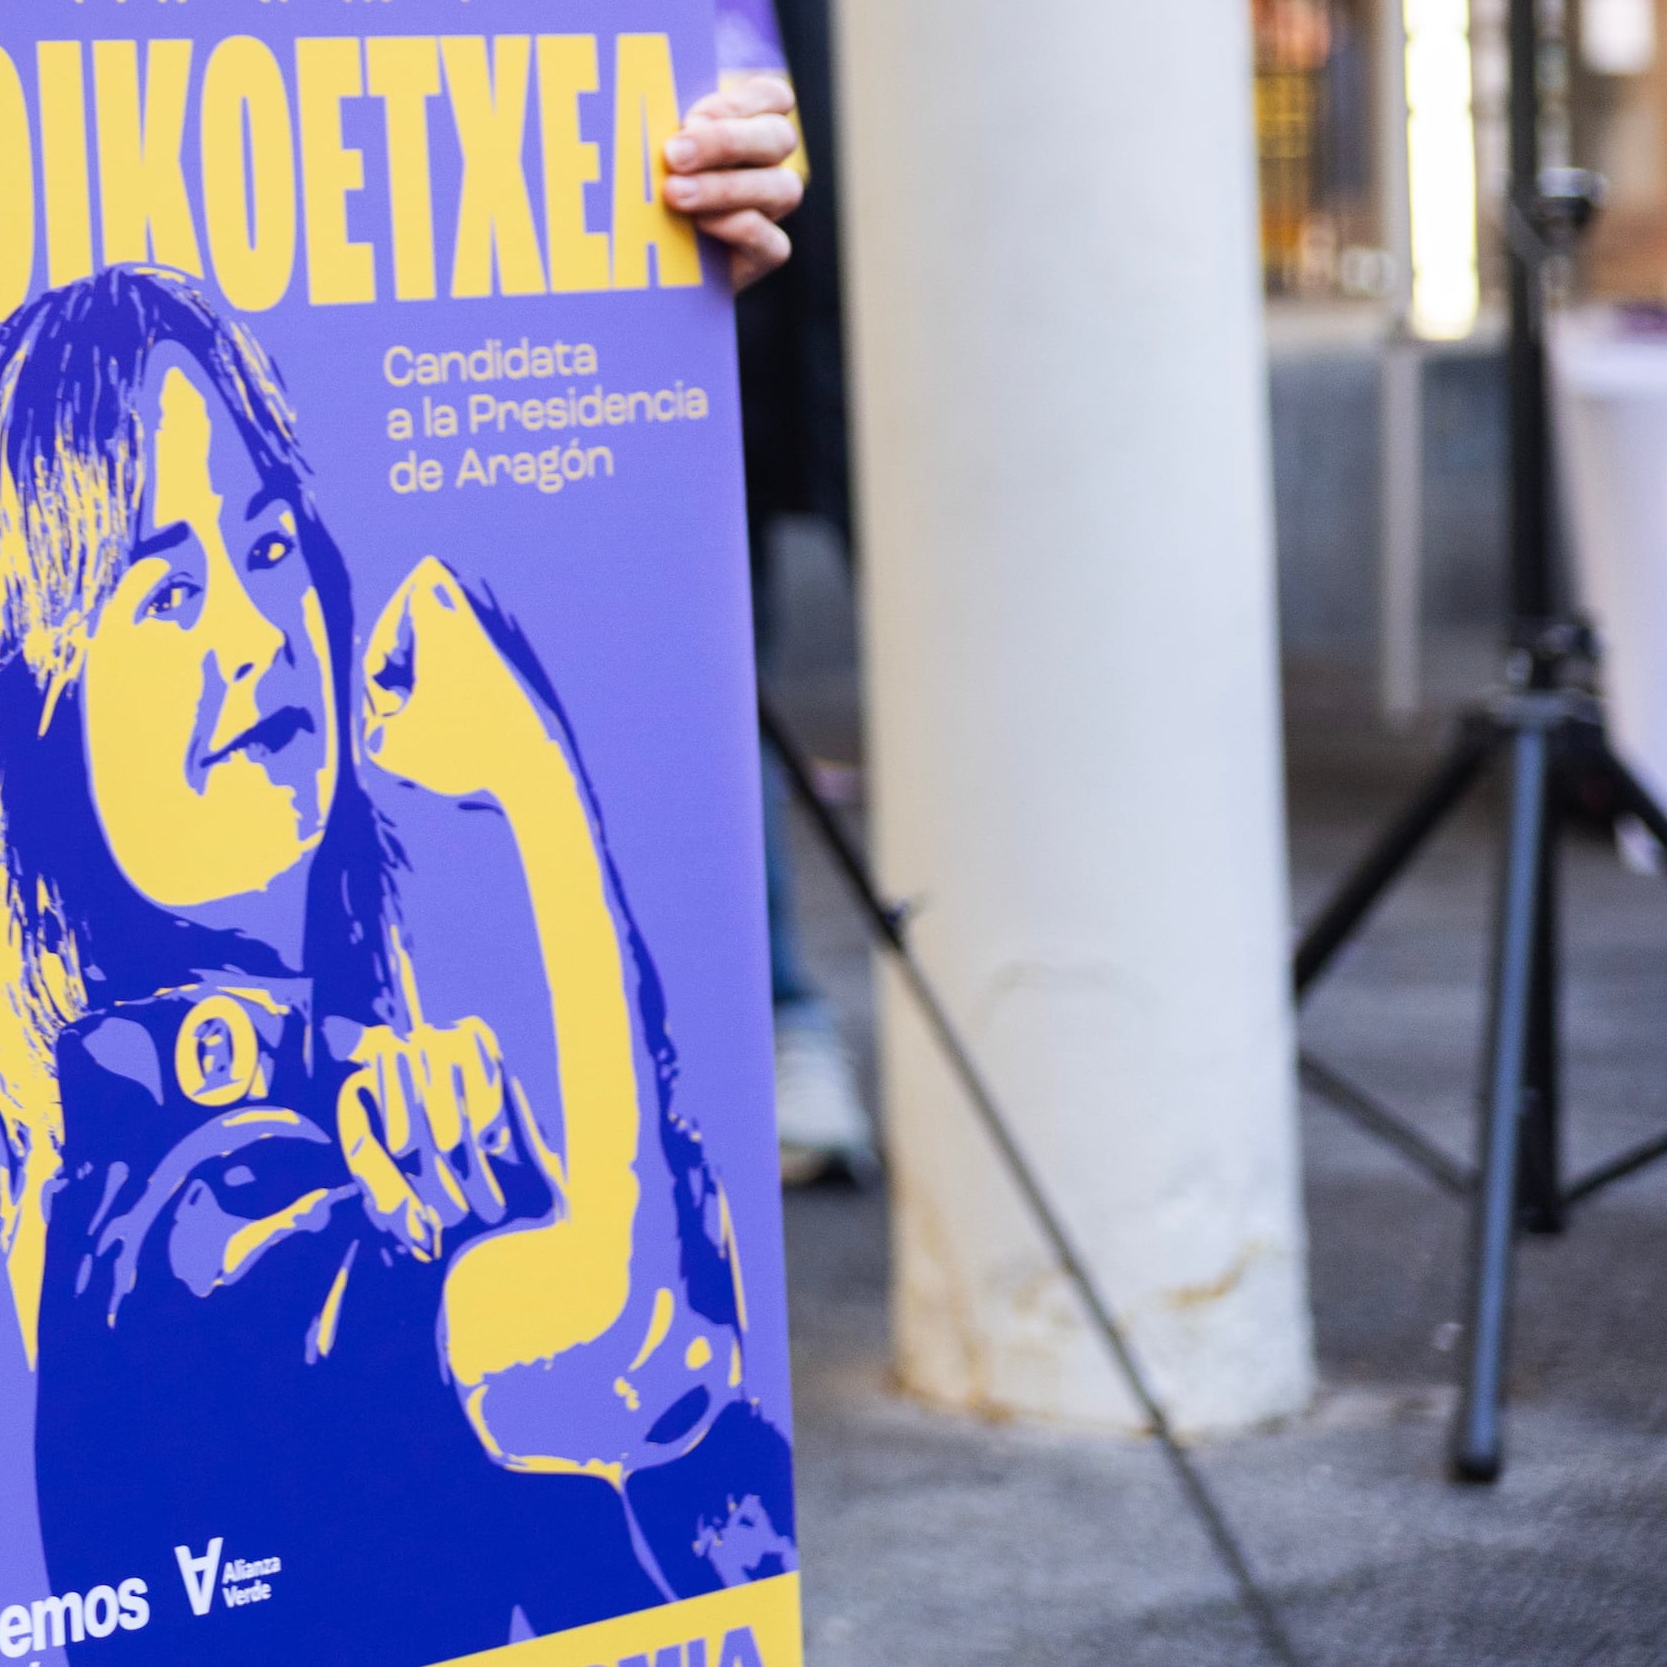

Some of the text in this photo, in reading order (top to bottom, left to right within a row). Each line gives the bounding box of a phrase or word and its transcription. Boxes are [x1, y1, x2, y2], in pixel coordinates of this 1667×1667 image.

[383, 338, 597, 386] Candidata
[387, 381, 708, 441] a la Presidencia
[390, 436, 613, 494] de Aragón
[221, 1553, 282, 1584] Alianza
[221, 1578, 272, 1608] Verde
